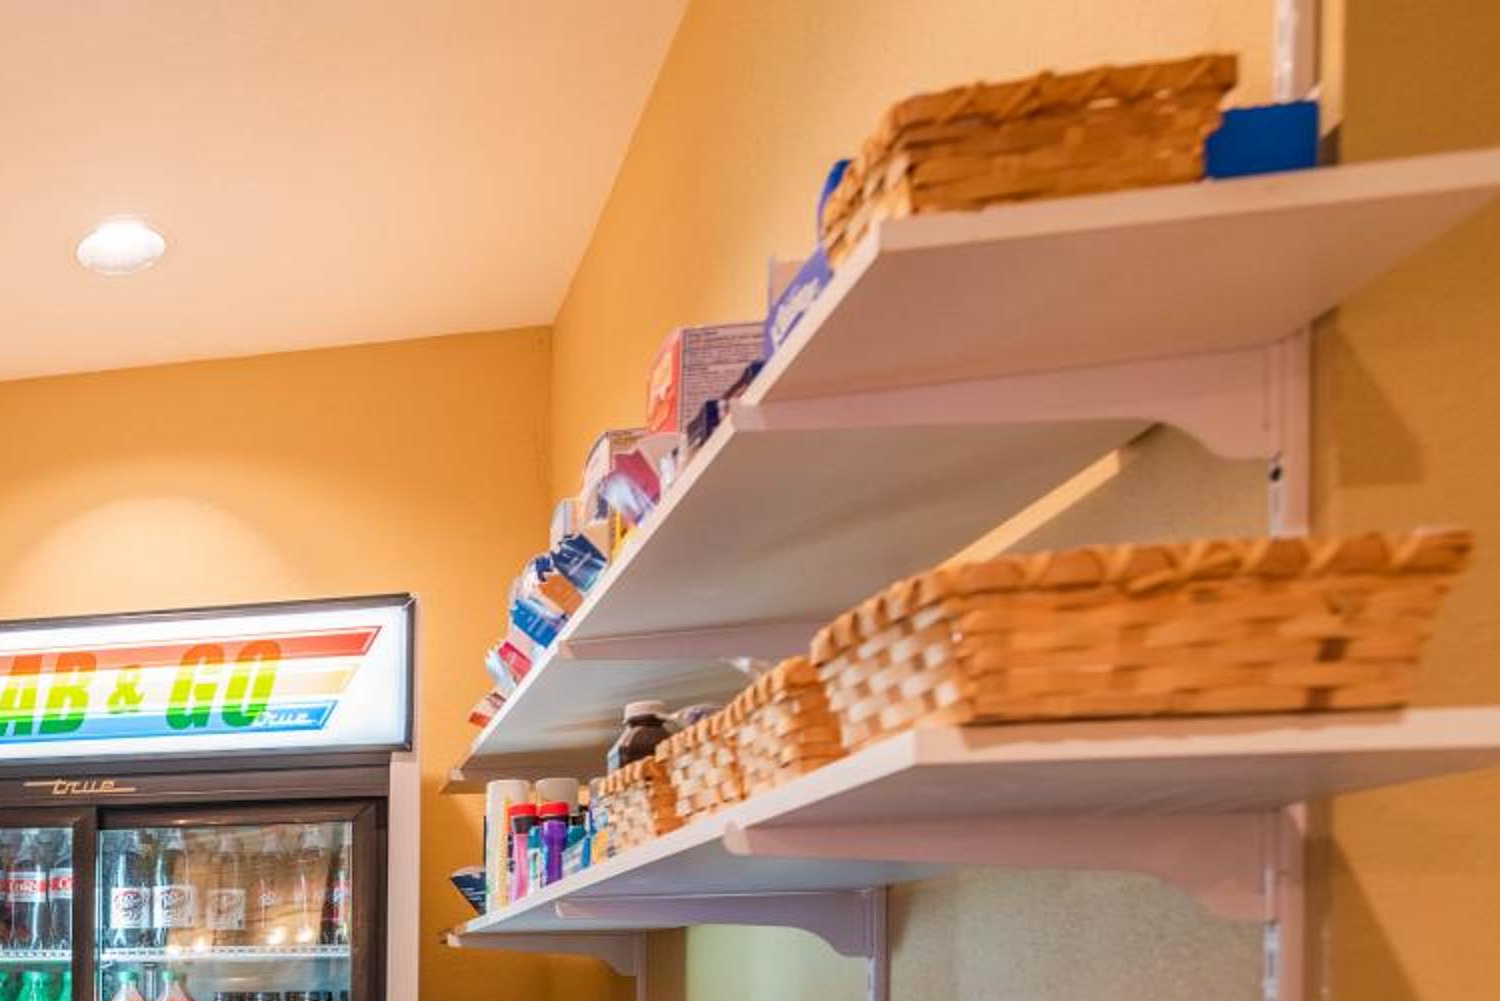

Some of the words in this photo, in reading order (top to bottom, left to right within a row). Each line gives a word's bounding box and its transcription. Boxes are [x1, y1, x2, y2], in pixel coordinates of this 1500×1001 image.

[105, 665, 146, 714] &
[165, 639, 282, 732] GO
[24, 779, 137, 796] true
